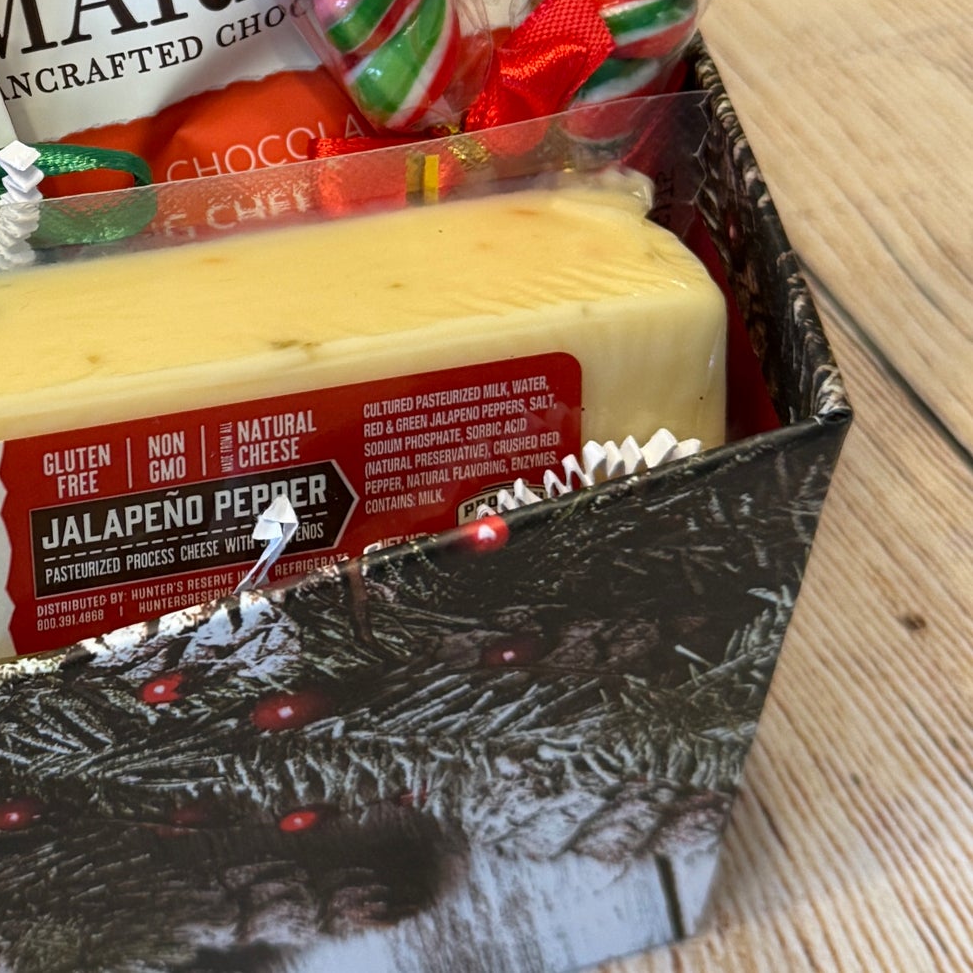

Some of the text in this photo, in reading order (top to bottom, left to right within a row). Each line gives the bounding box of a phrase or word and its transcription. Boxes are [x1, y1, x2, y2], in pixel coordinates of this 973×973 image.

[363, 376, 549, 419] CULTURED PASTEURIZED MILK, WATER,
[364, 422, 382, 438] RED
[386, 420, 394, 435] &
[396, 414, 427, 433] GREEN
[482, 398, 527, 417] PEPPERS,
[529, 393, 557, 411] SALT,
[237, 410, 317, 444] NATURAL
[364, 417, 527, 457] SODIUM PHOSPHATE, SORBIC ACID
[43, 430, 186, 476] GLUTEN NON
[238, 436, 300, 469] CHEESE
[365, 431, 559, 479] (NATURAL PRESERVATIVE), CRUSHED RED
[365, 451, 560, 496] PEPPER, NATURAL FLAVORING, ENZYMES.
[57, 456, 186, 499] FREE GMO
[41, 473, 328, 550] JALAPEÑO PEPPER
[365, 488, 445, 514] CONTAINS: MILK.
[45, 556, 122, 585] PASTEURIZED
[126, 547, 176, 572] PROCESS
[180, 539, 220, 562] CHEESE
[225, 533, 255, 554] WITH
[37, 595, 107, 618] DISTRIBUTED
[110, 591, 128, 606] BY:
[131, 581, 183, 601] HUNTER'S
[187, 574, 234, 593] RESERVE
